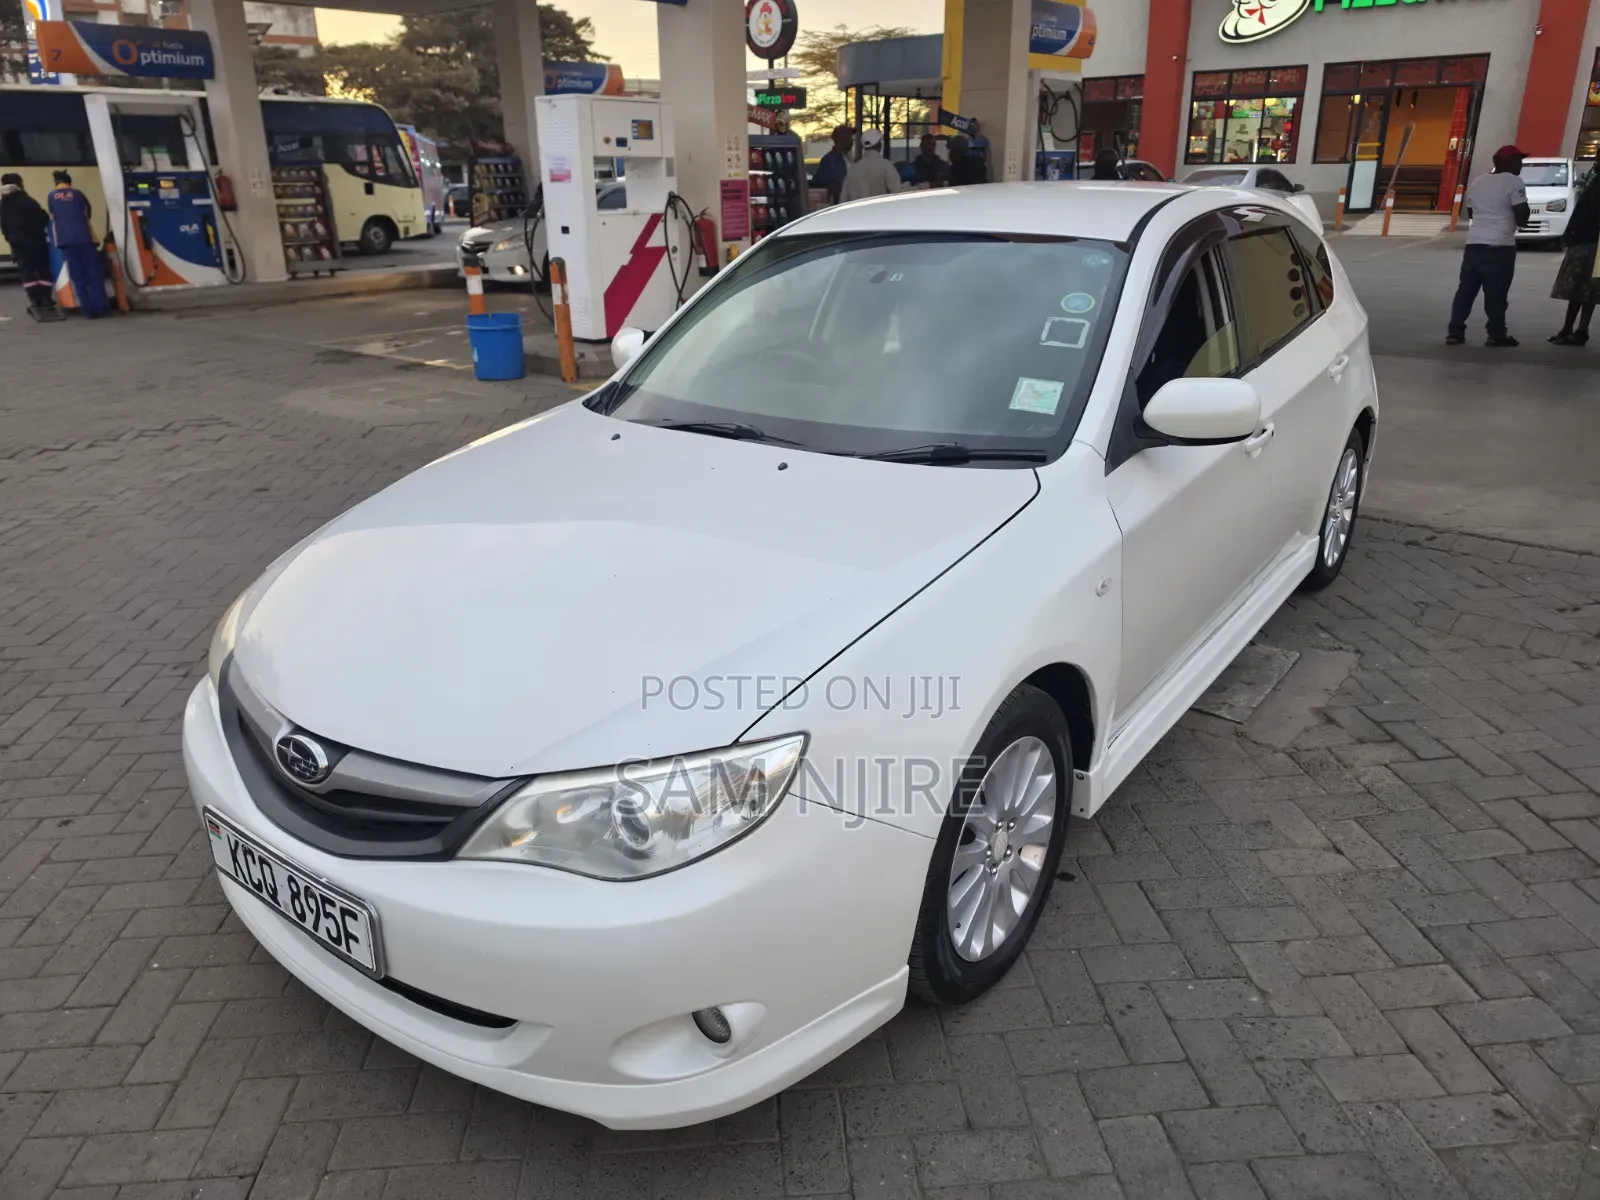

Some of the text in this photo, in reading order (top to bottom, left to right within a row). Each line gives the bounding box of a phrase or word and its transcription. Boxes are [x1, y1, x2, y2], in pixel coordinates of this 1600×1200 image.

[1031, 24, 1067, 41] ptimium
[51, 49, 62, 62] 7
[112, 39, 205, 67] Optimium
[757, 92, 782, 105] Pizza
[226, 832, 360, 955] KCQ 895F
